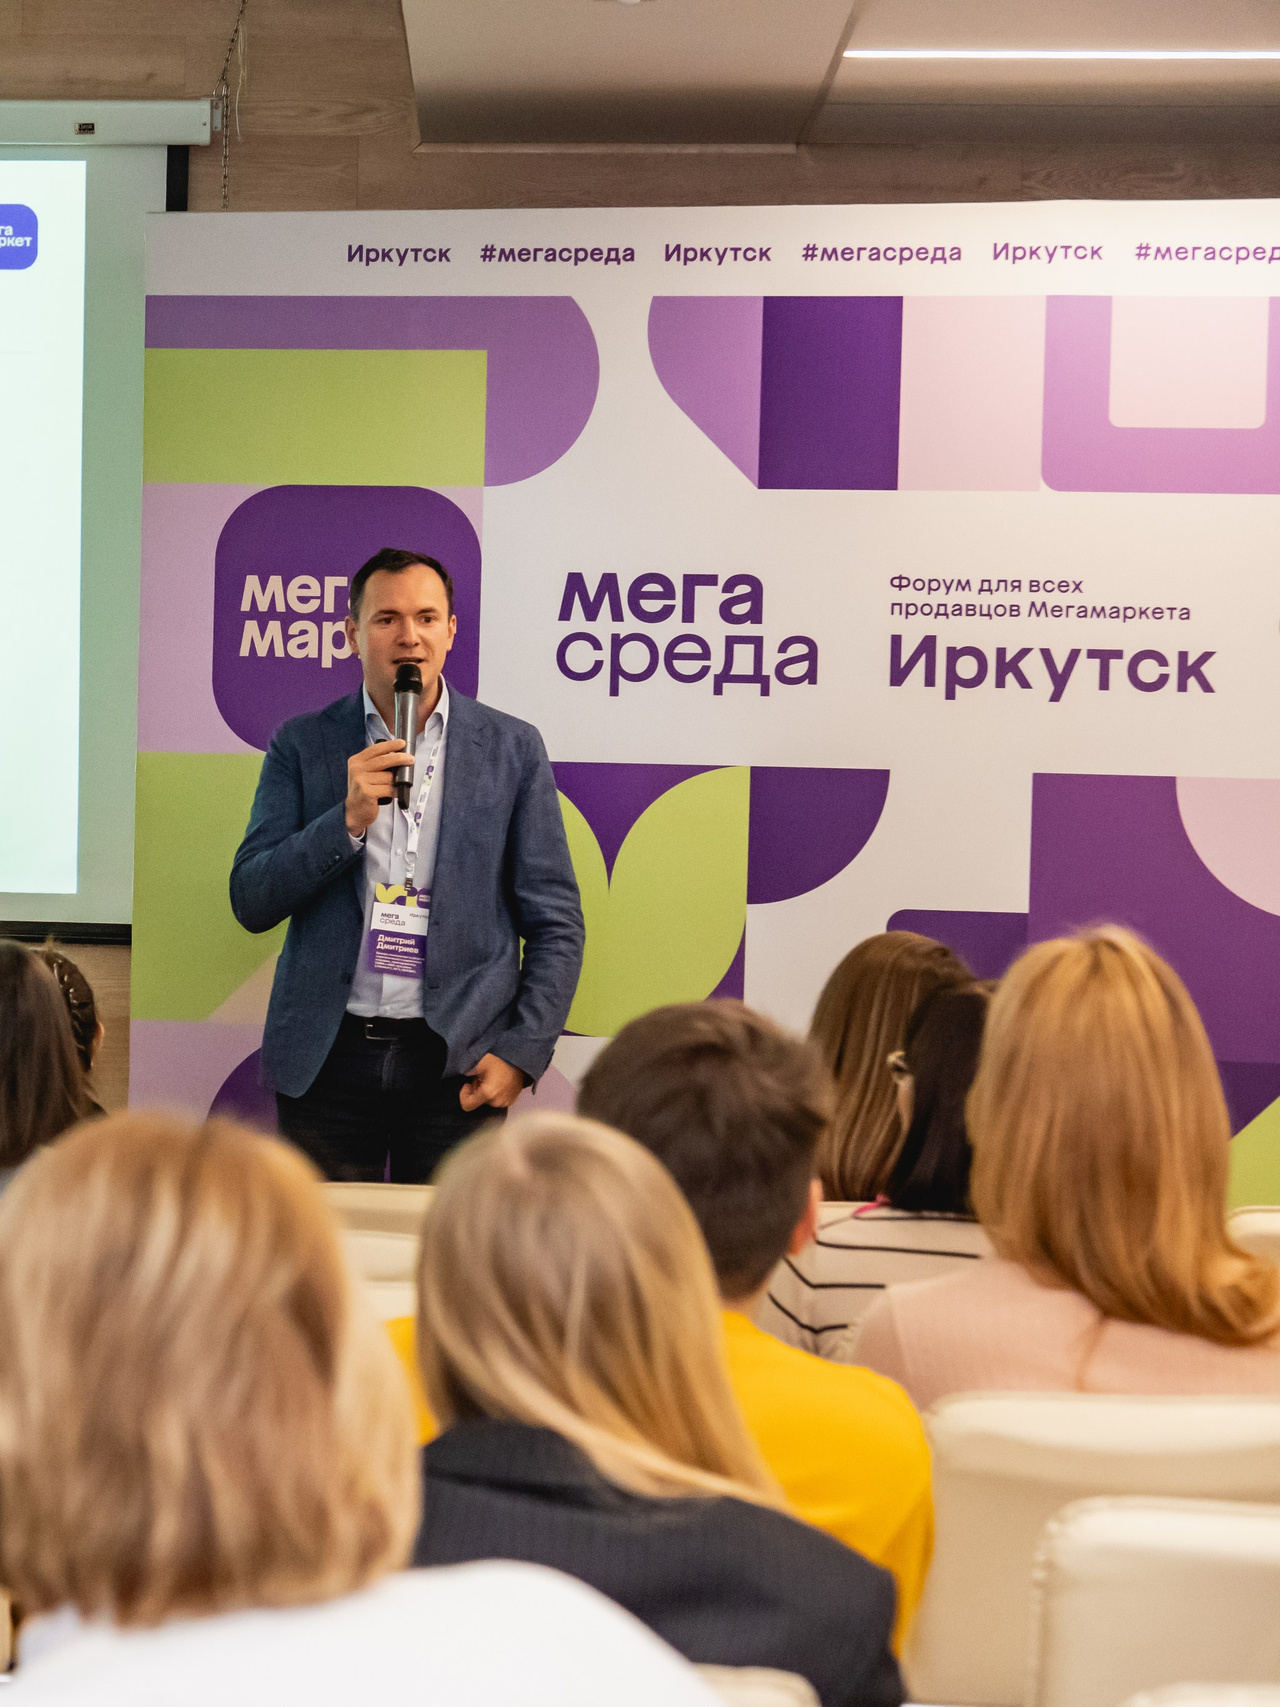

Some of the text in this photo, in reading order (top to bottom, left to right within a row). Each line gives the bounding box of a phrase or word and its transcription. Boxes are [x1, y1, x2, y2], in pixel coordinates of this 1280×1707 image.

[347, 242, 1280, 266] Иркутск #мегасреда Иркутск #мегасреда Иркутск #мегасред
[240, 574, 351, 614] мег
[890, 574, 1084, 596] Форум для всех
[557, 571, 764, 625] мега
[890, 601, 1191, 623] продавцов Мегамаркета
[239, 620, 359, 669] мар
[556, 631, 819, 697] среда
[889, 633, 1218, 703] Иркутск
[379, 918, 406, 927] среда
[381, 912, 400, 920] мега
[376, 942, 420, 954] Дмитриев
[377, 934, 416, 946] Дмитрий
